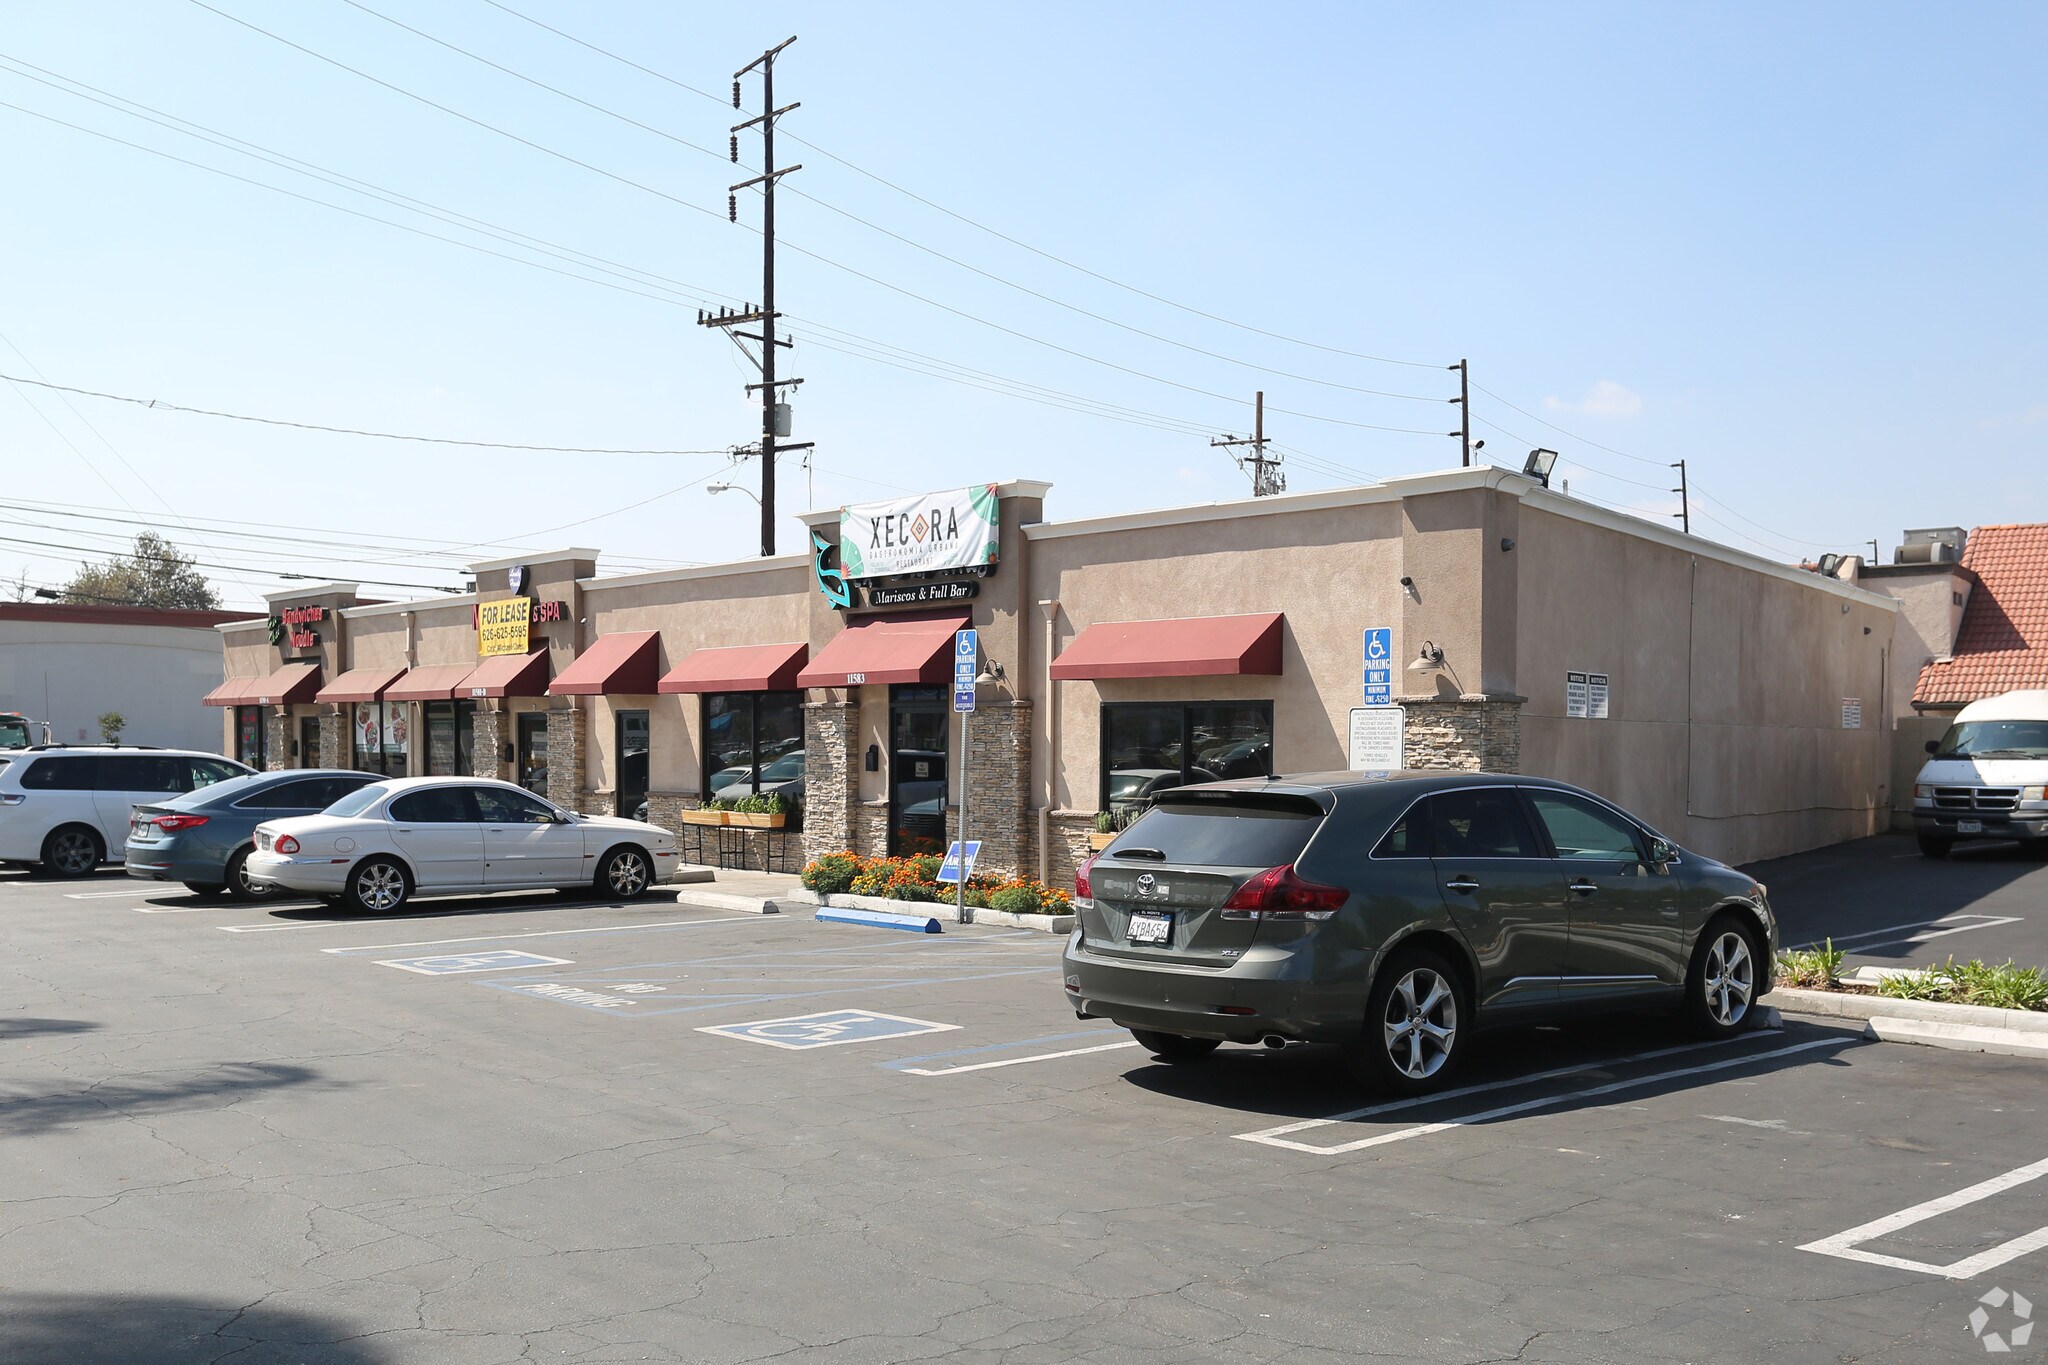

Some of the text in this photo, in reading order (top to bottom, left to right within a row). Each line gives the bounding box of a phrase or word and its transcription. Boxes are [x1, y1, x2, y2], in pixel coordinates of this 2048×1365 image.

[875, 584, 968, 604] Mariscos & Full Bar
[282, 606, 322, 624] Sandwiches
[482, 604, 498, 625] FOR
[500, 602, 528, 623] LEASE
[540, 601, 560, 622] SPA
[482, 625, 527, 641] 626-625-5595
[956, 654, 975, 663] PARKING
[1365, 659, 1390, 670] PARKING
[959, 664, 971, 674] ONLY
[847, 673, 865, 684] 11583
[1369, 671, 1385, 683] ONLY
[1367, 686, 1387, 694] MINIMUM
[1365, 695, 1375, 703] FINE
[1129, 921, 1168, 938] 6YBA656
